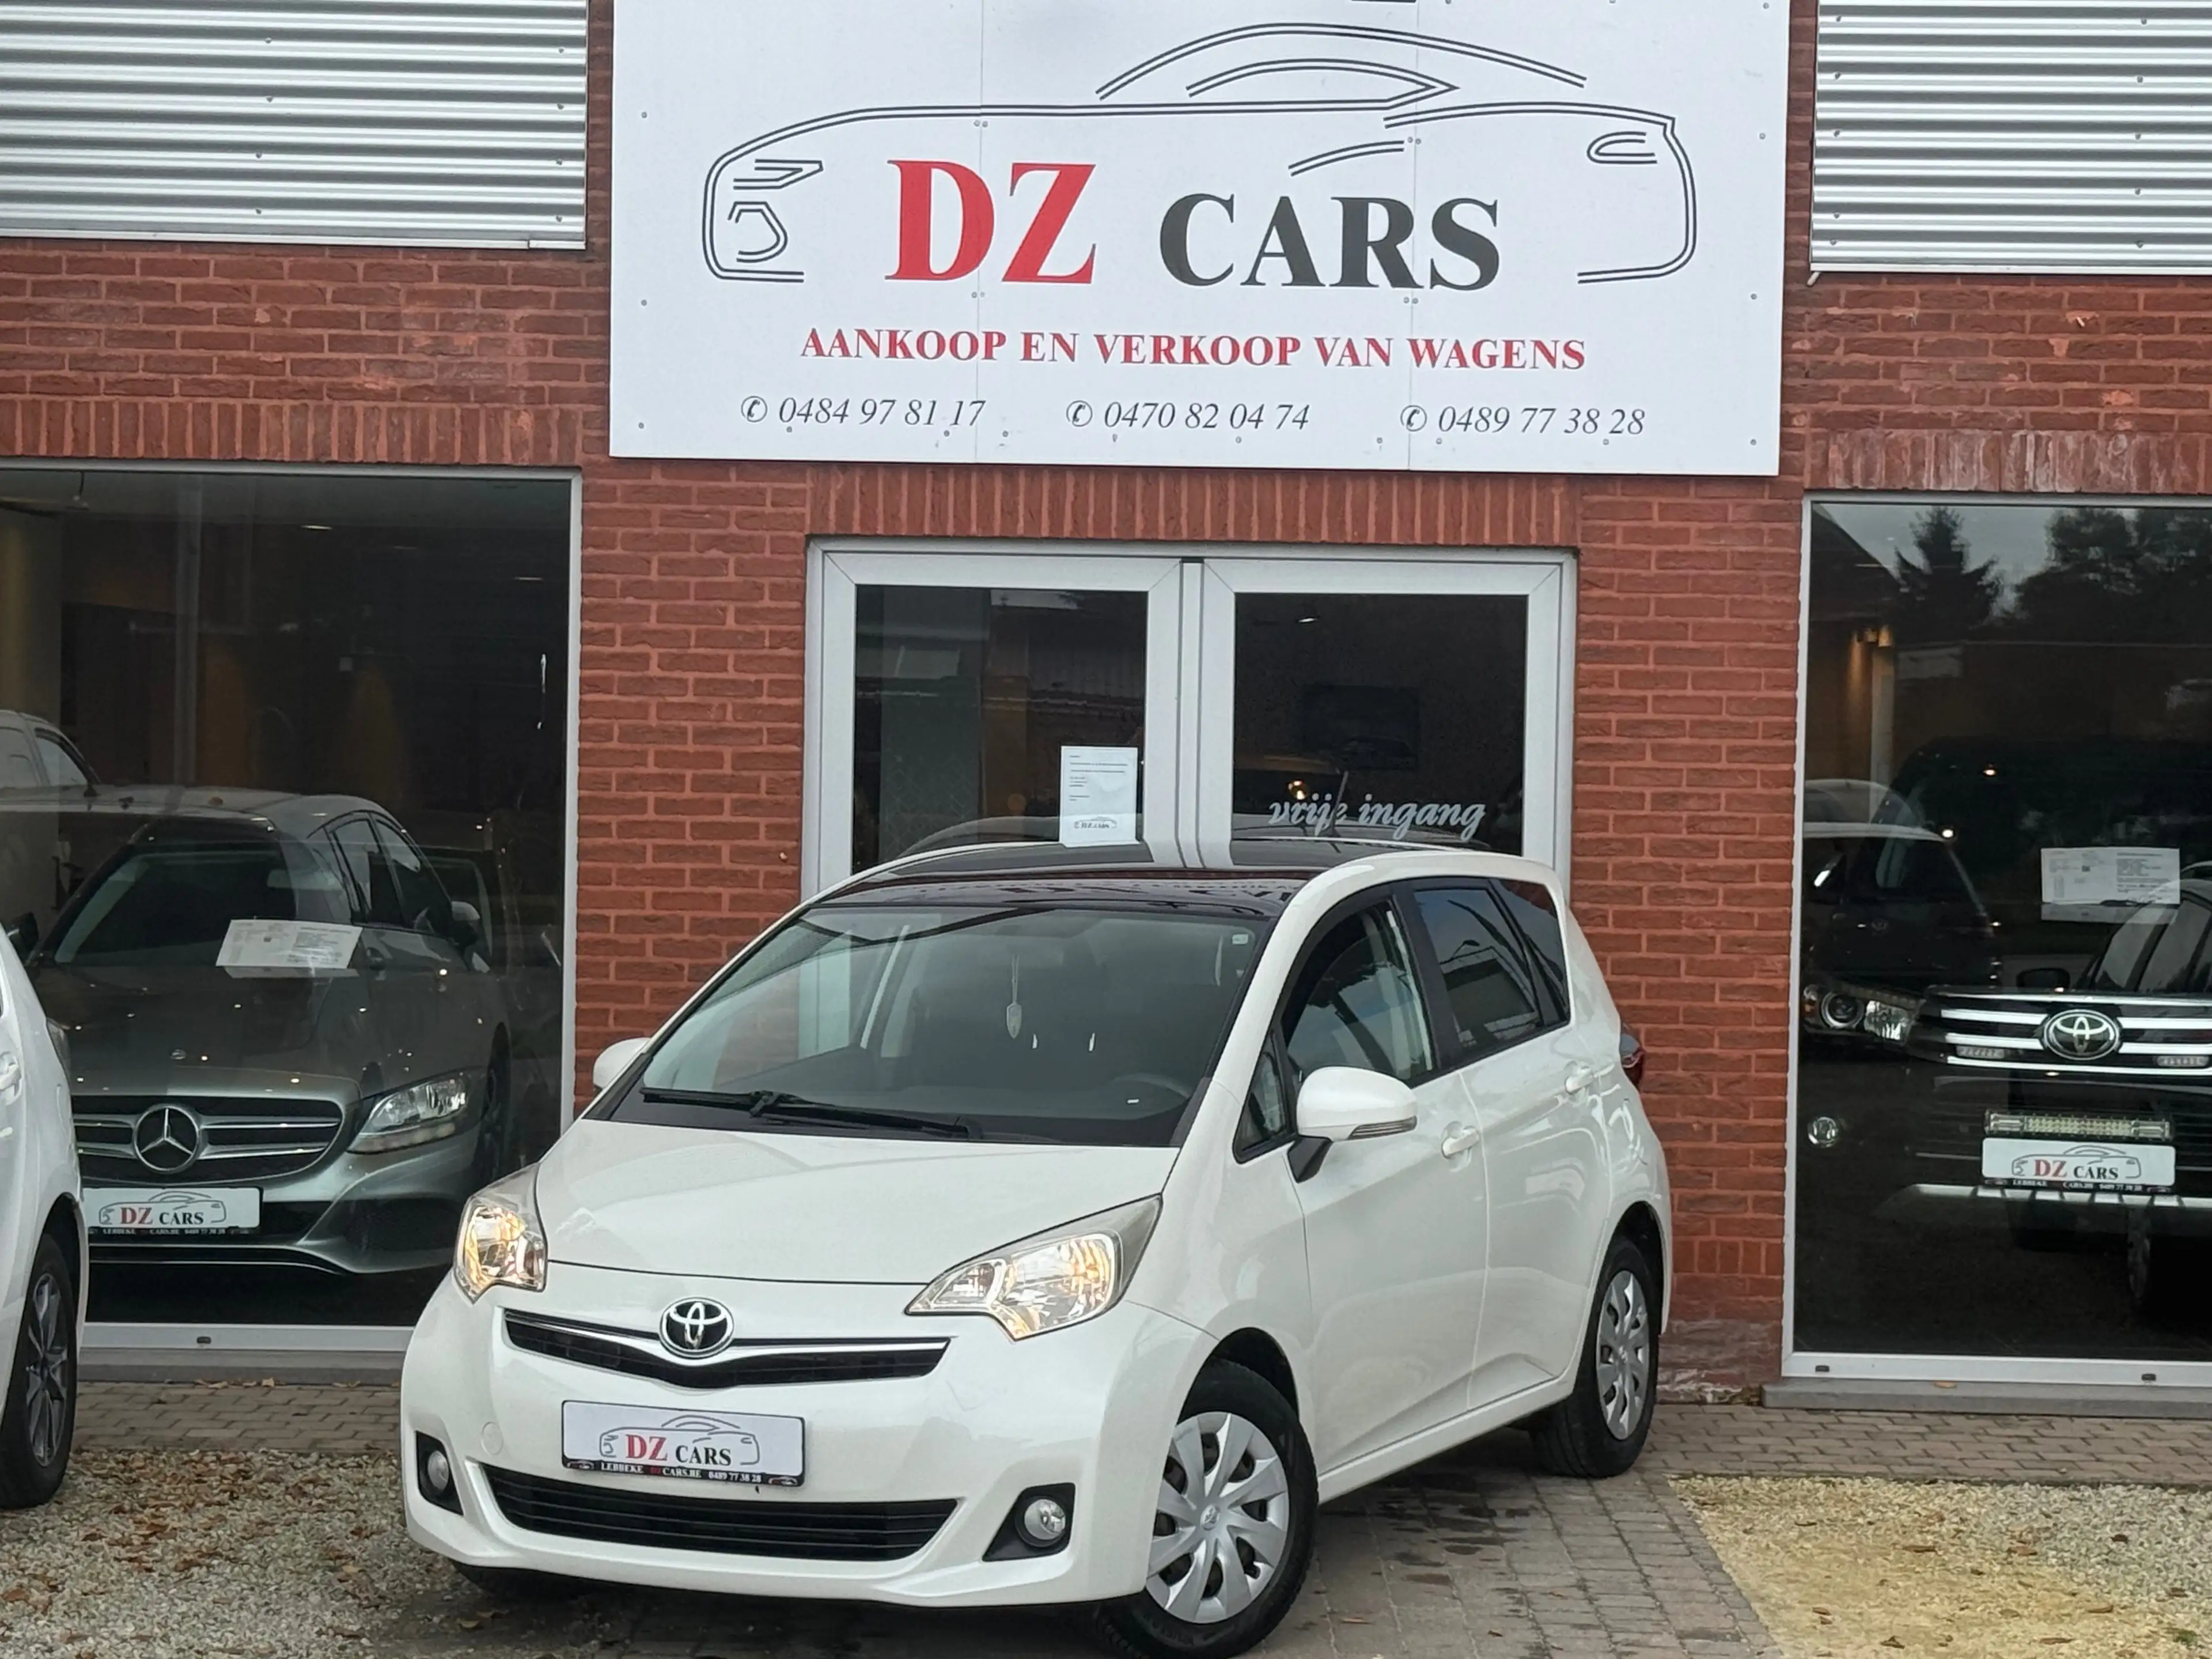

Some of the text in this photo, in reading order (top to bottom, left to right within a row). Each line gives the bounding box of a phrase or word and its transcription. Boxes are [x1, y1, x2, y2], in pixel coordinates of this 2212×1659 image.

[885, 159, 1501, 291] DZ CARS
[801, 328, 1586, 370] AANKOOP EN VERKOOP VAN WAGENS
[778, 397, 987, 427] 0484 97 81 17
[1104, 401, 1310, 431] 0470 82 04 74
[1438, 406, 1646, 435] 0489 77 38 28
[1268, 793, 1487, 843] vrije ingang
[2034, 1159, 2119, 1180] DZ CARS
[120, 1207, 204, 1225] DZ CARS
[624, 1434, 732, 1467] DZ CARS
